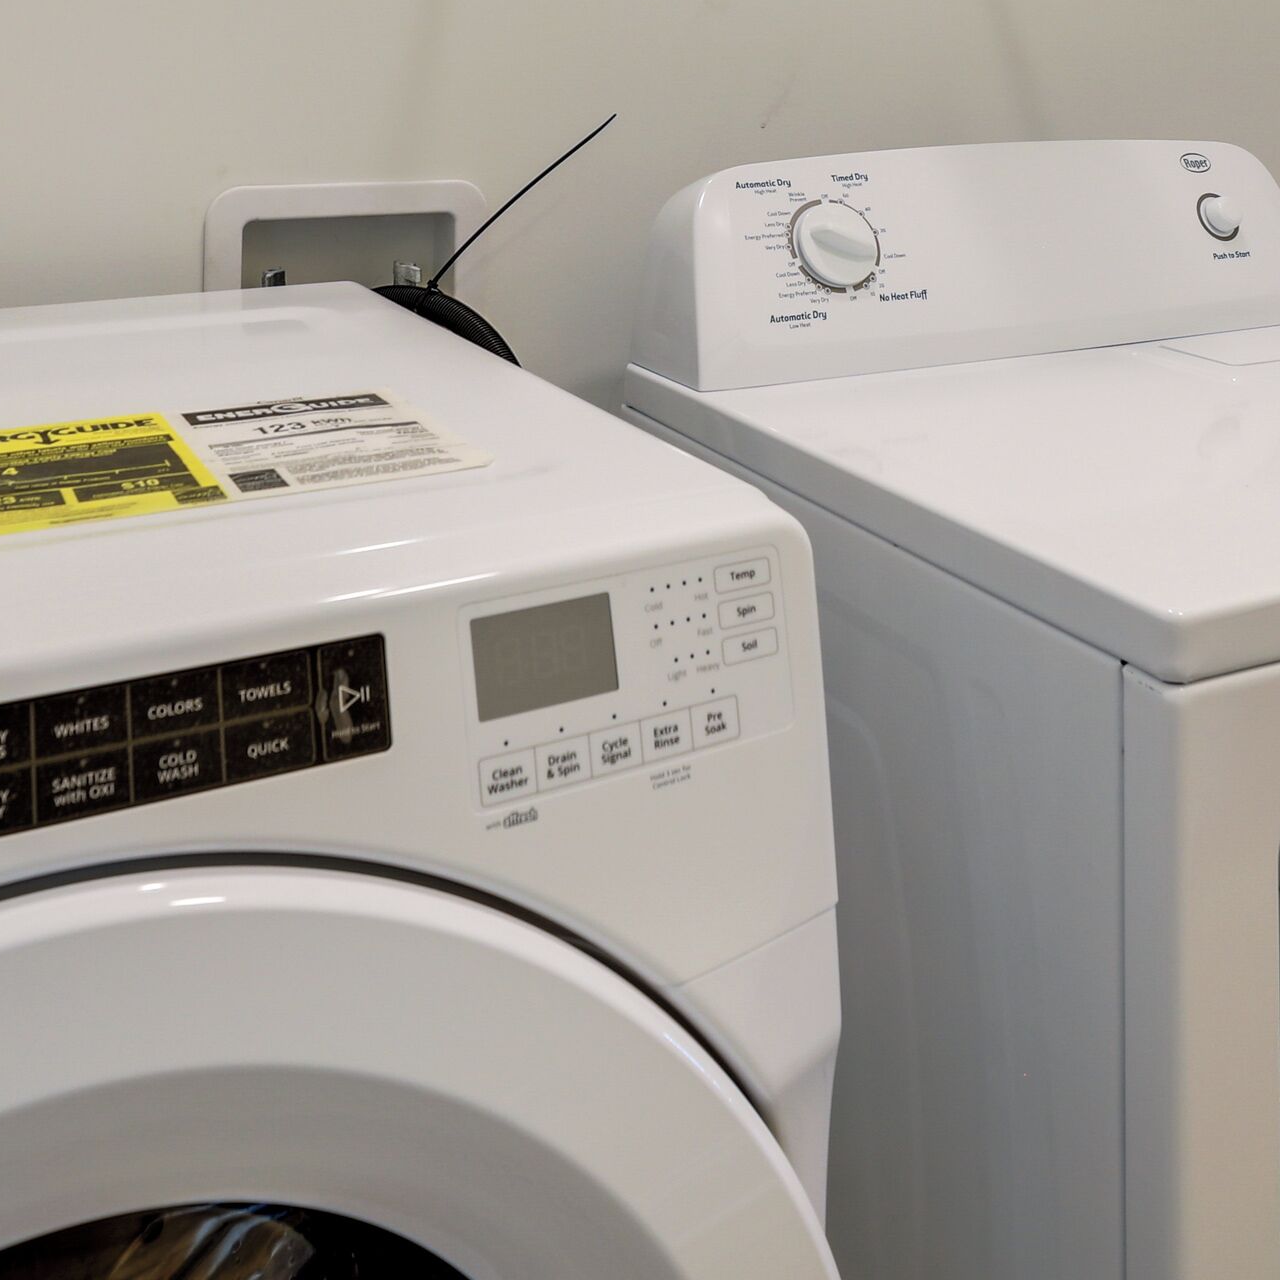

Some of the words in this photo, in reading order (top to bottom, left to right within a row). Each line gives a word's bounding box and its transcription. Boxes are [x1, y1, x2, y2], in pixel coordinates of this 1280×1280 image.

[1182, 158, 1208, 169] Roper
[736, 180, 776, 189] Automatic
[777, 179, 791, 188] Dry
[831, 174, 853, 182] Timed
[855, 173, 869, 182] Dry
[1213, 252, 1228, 260] Push
[880, 294, 890, 302] No
[891, 292, 909, 300] Heat
[910, 290, 927, 300] Fluff
[770, 312, 811, 324] Automatic
[813, 310, 827, 320] Dry
[253, 420, 306, 436] 123
[120, 479, 160, 490] $10
[730, 569, 756, 581] Temp
[694, 592, 709, 601] Hot
[644, 602, 663, 612] Cold
[736, 604, 756, 618] Spin
[697, 627, 713, 637] Fast
[650, 638, 663, 649] Off
[741, 639, 758, 652] Soil
[696, 662, 720, 673] Heavy
[667, 669, 687, 682] Light
[238, 680, 292, 704] TOWELS
[147, 696, 204, 720] COLORS
[706, 711, 723, 722] Pre
[54, 714, 110, 739] WHITES
[362, 721, 381, 732] Start
[653, 724, 678, 738] Extra
[705, 722, 727, 736] Soak
[247, 738, 290, 759] QUICK
[602, 736, 628, 753] Cycle
[654, 735, 680, 750] Rinse
[158, 750, 197, 770] COLD
[548, 751, 577, 766] Drain
[601, 748, 632, 765] Signal
[158, 764, 200, 784] WASH
[492, 765, 524, 782] Clean
[546, 768, 556, 779] &
[558, 763, 580, 777] Spin
[52, 766, 116, 794] SANITIZE
[487, 777, 530, 796] Washer
[54, 790, 86, 808] with
[89, 783, 116, 800] OXI
